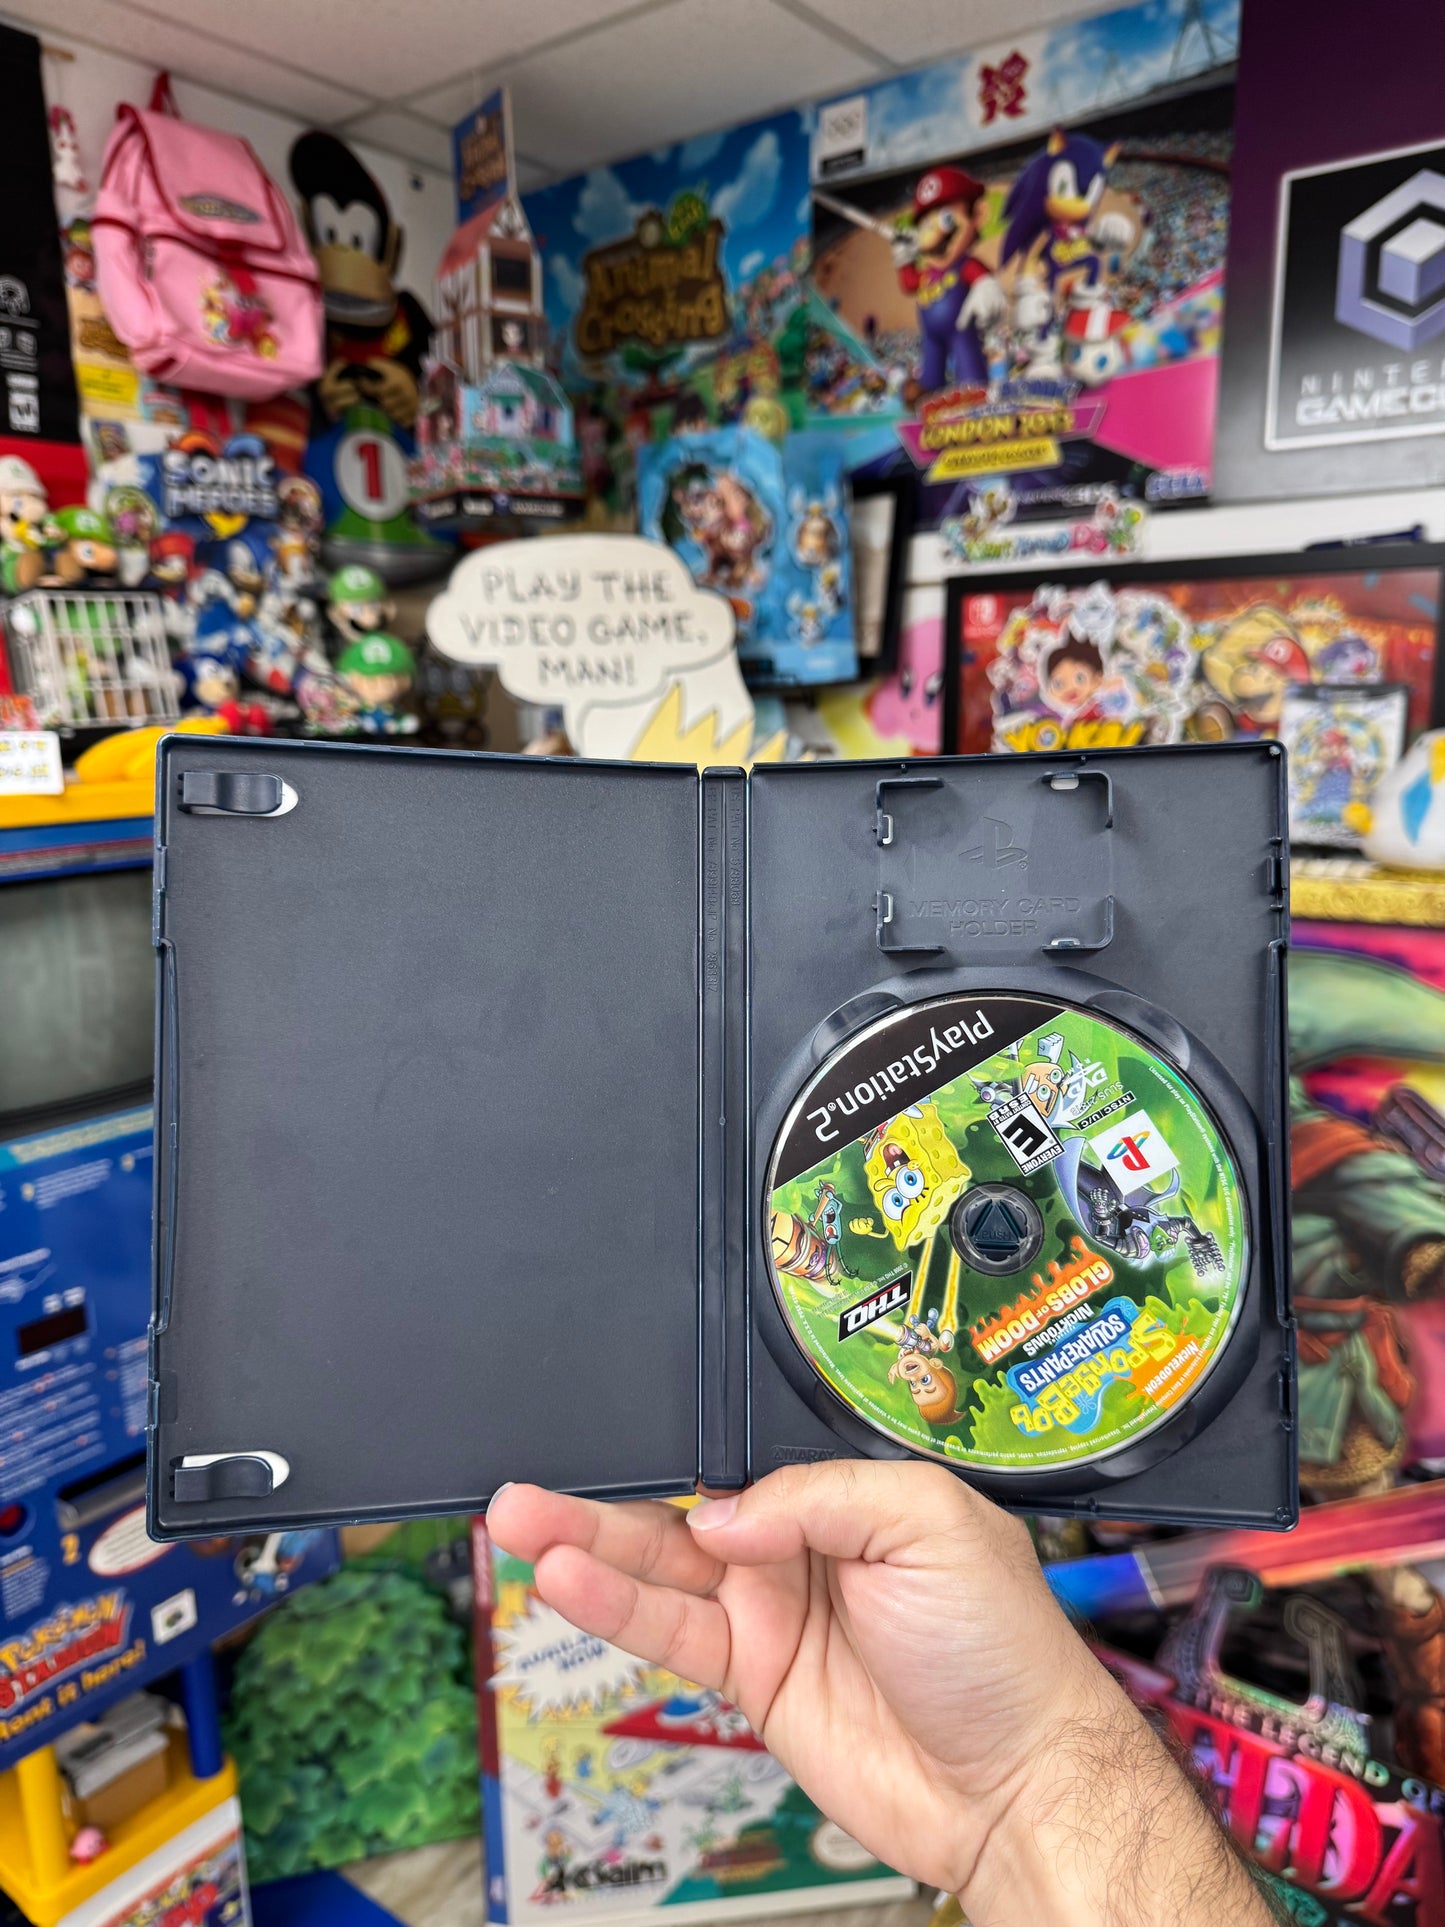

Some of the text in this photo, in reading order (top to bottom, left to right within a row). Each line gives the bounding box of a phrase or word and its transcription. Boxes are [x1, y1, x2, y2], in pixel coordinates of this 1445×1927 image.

[481, 567, 674, 602] PLAY THE
[458, 611, 577, 647] VIDEO
[908, 898, 1081, 918] MEMORY CARD
[948, 920, 1040, 938] HOLDER
[1096, 1080, 1123, 1101] SLUS
[1147, 1065, 1168, 1084] Licensed
[987, 1092, 1028, 1121] ESRB
[1079, 1093, 1131, 1128] NTSC U/C
[1001, 1113, 1047, 1157] E
[1020, 1143, 1062, 1174] EVERYONE
[843, 1281, 909, 1333] THQ
[975, 1257, 1111, 1361] GLOBS OF DOOM
[1021, 1302, 1094, 1357] NICKTOONS
[1020, 1314, 1125, 1391] SQUAREPANTS
